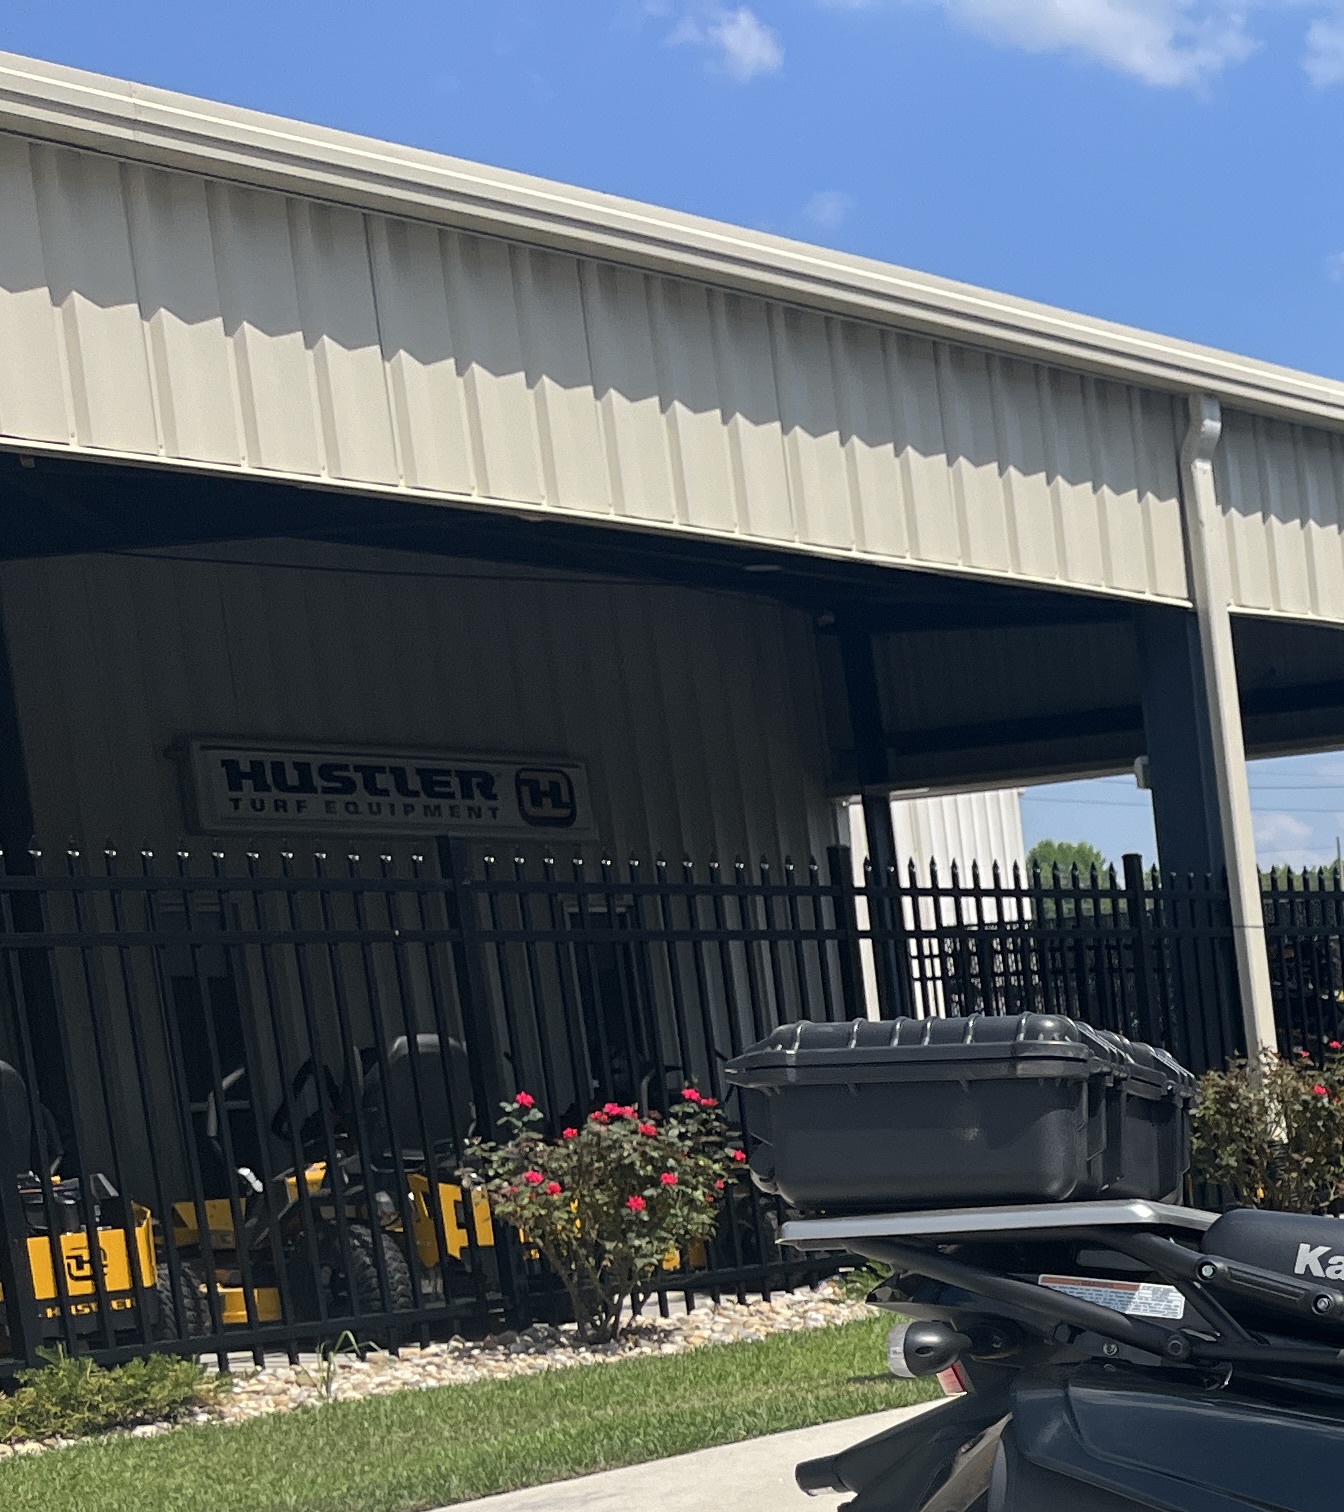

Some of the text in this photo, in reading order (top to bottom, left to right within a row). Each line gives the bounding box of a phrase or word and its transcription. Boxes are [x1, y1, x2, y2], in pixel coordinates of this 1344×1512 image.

[220, 758, 499, 801] HUSTLER
[228, 797, 500, 820] TURF EQUIPMENT
